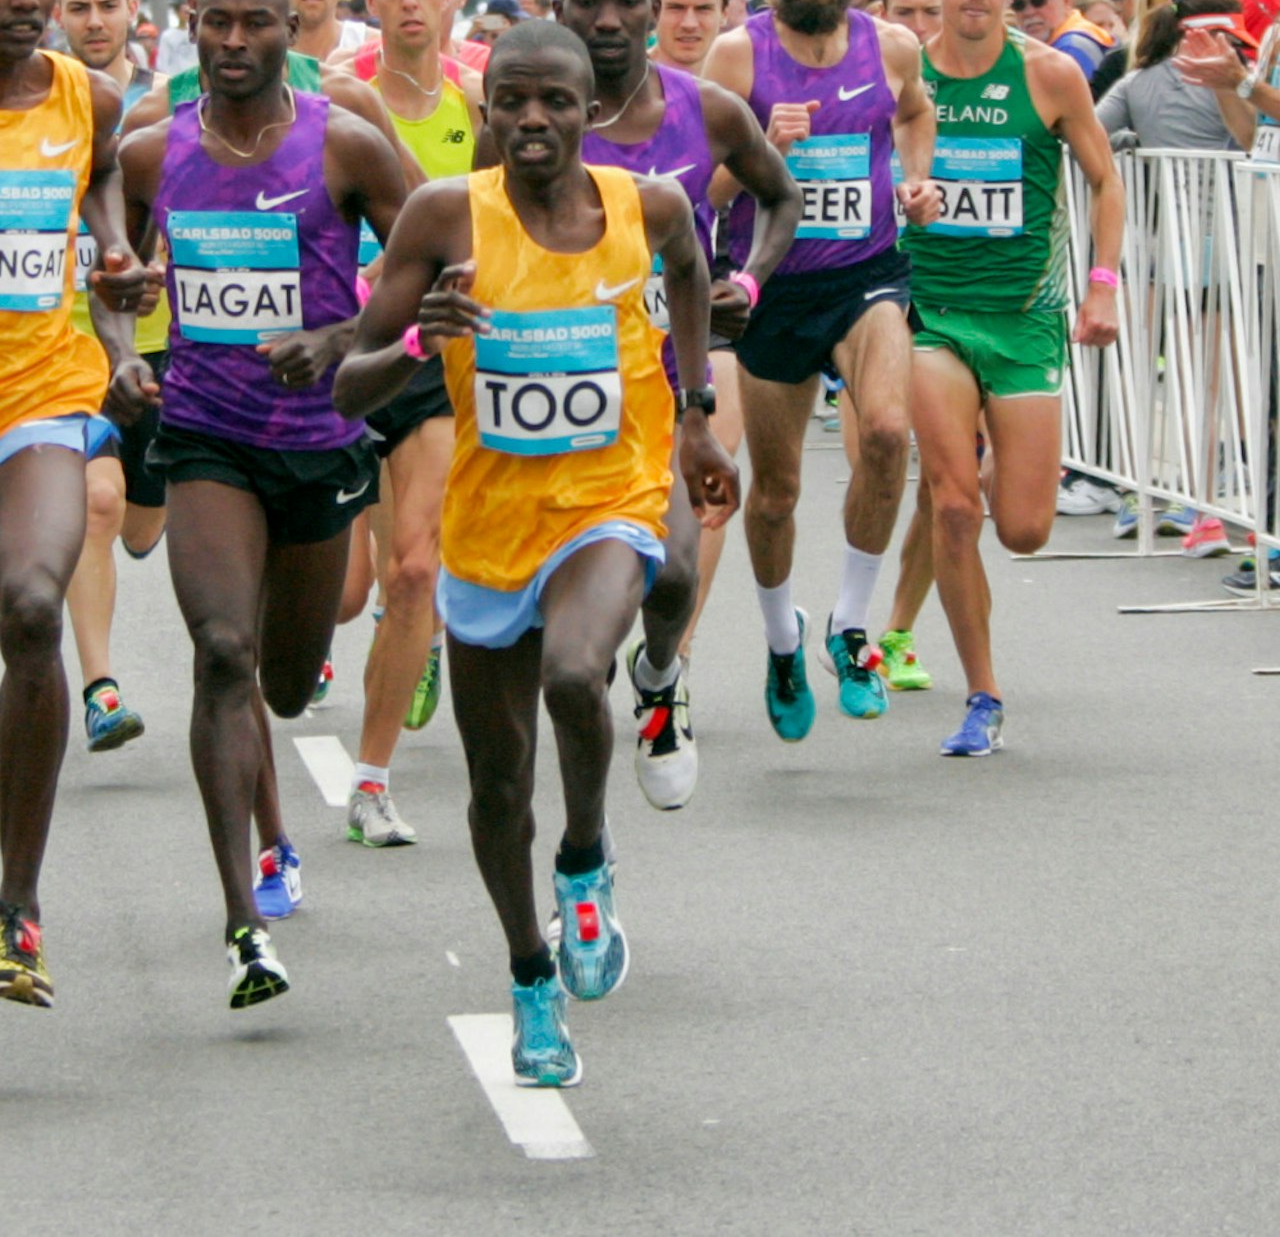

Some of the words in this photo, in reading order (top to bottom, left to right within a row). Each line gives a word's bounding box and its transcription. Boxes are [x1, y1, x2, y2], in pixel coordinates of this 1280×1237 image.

[935, 104, 1009, 125] ELAND
[786, 147, 838, 158] RLSBAD
[933, 148, 987, 160] ARLSBAD
[988, 149, 1020, 160] 5000
[801, 187, 862, 221] EER
[172, 227, 252, 241] CARLSBAD
[253, 227, 293, 241] 5000
[179, 280, 297, 318] LAGAT
[570, 323, 613, 340] 5000
[485, 380, 608, 432] TOO
